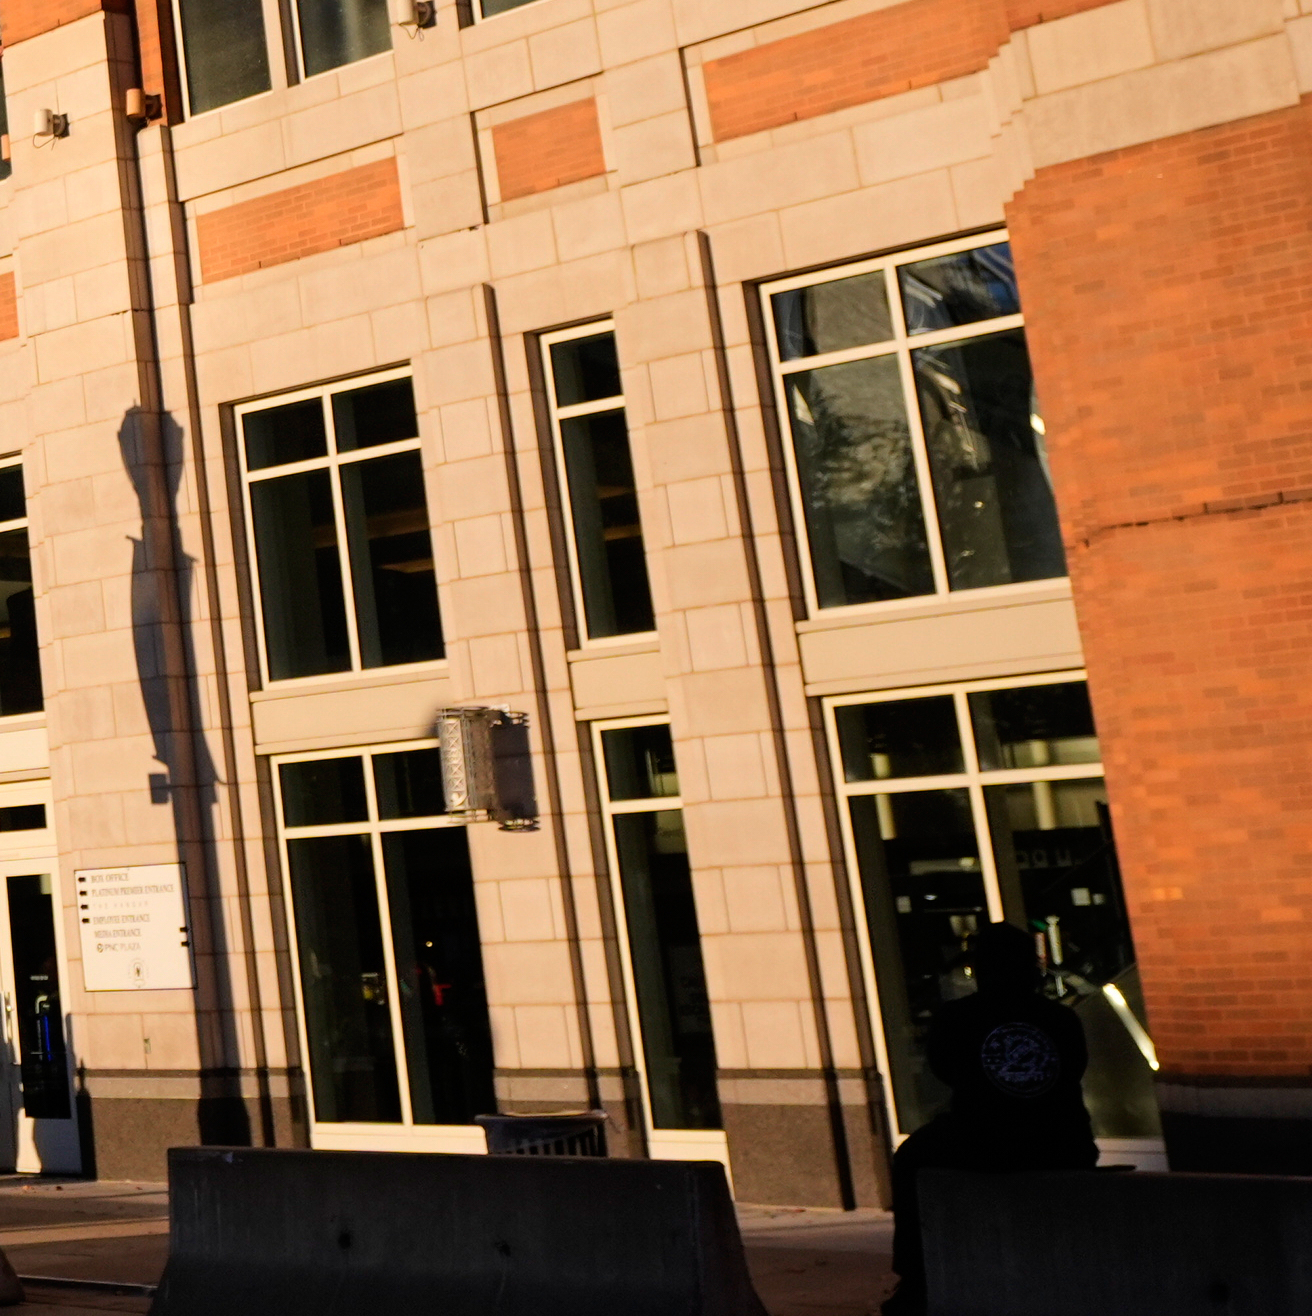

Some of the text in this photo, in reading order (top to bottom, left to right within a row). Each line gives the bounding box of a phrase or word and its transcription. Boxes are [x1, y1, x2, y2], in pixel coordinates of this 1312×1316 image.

[91, 873, 129, 884] BOX OFFICE
[144, 884, 175, 894] ENTRANCE
[121, 913, 151, 924] ENTRANCE
[113, 928, 142, 938] ENTRANCE
